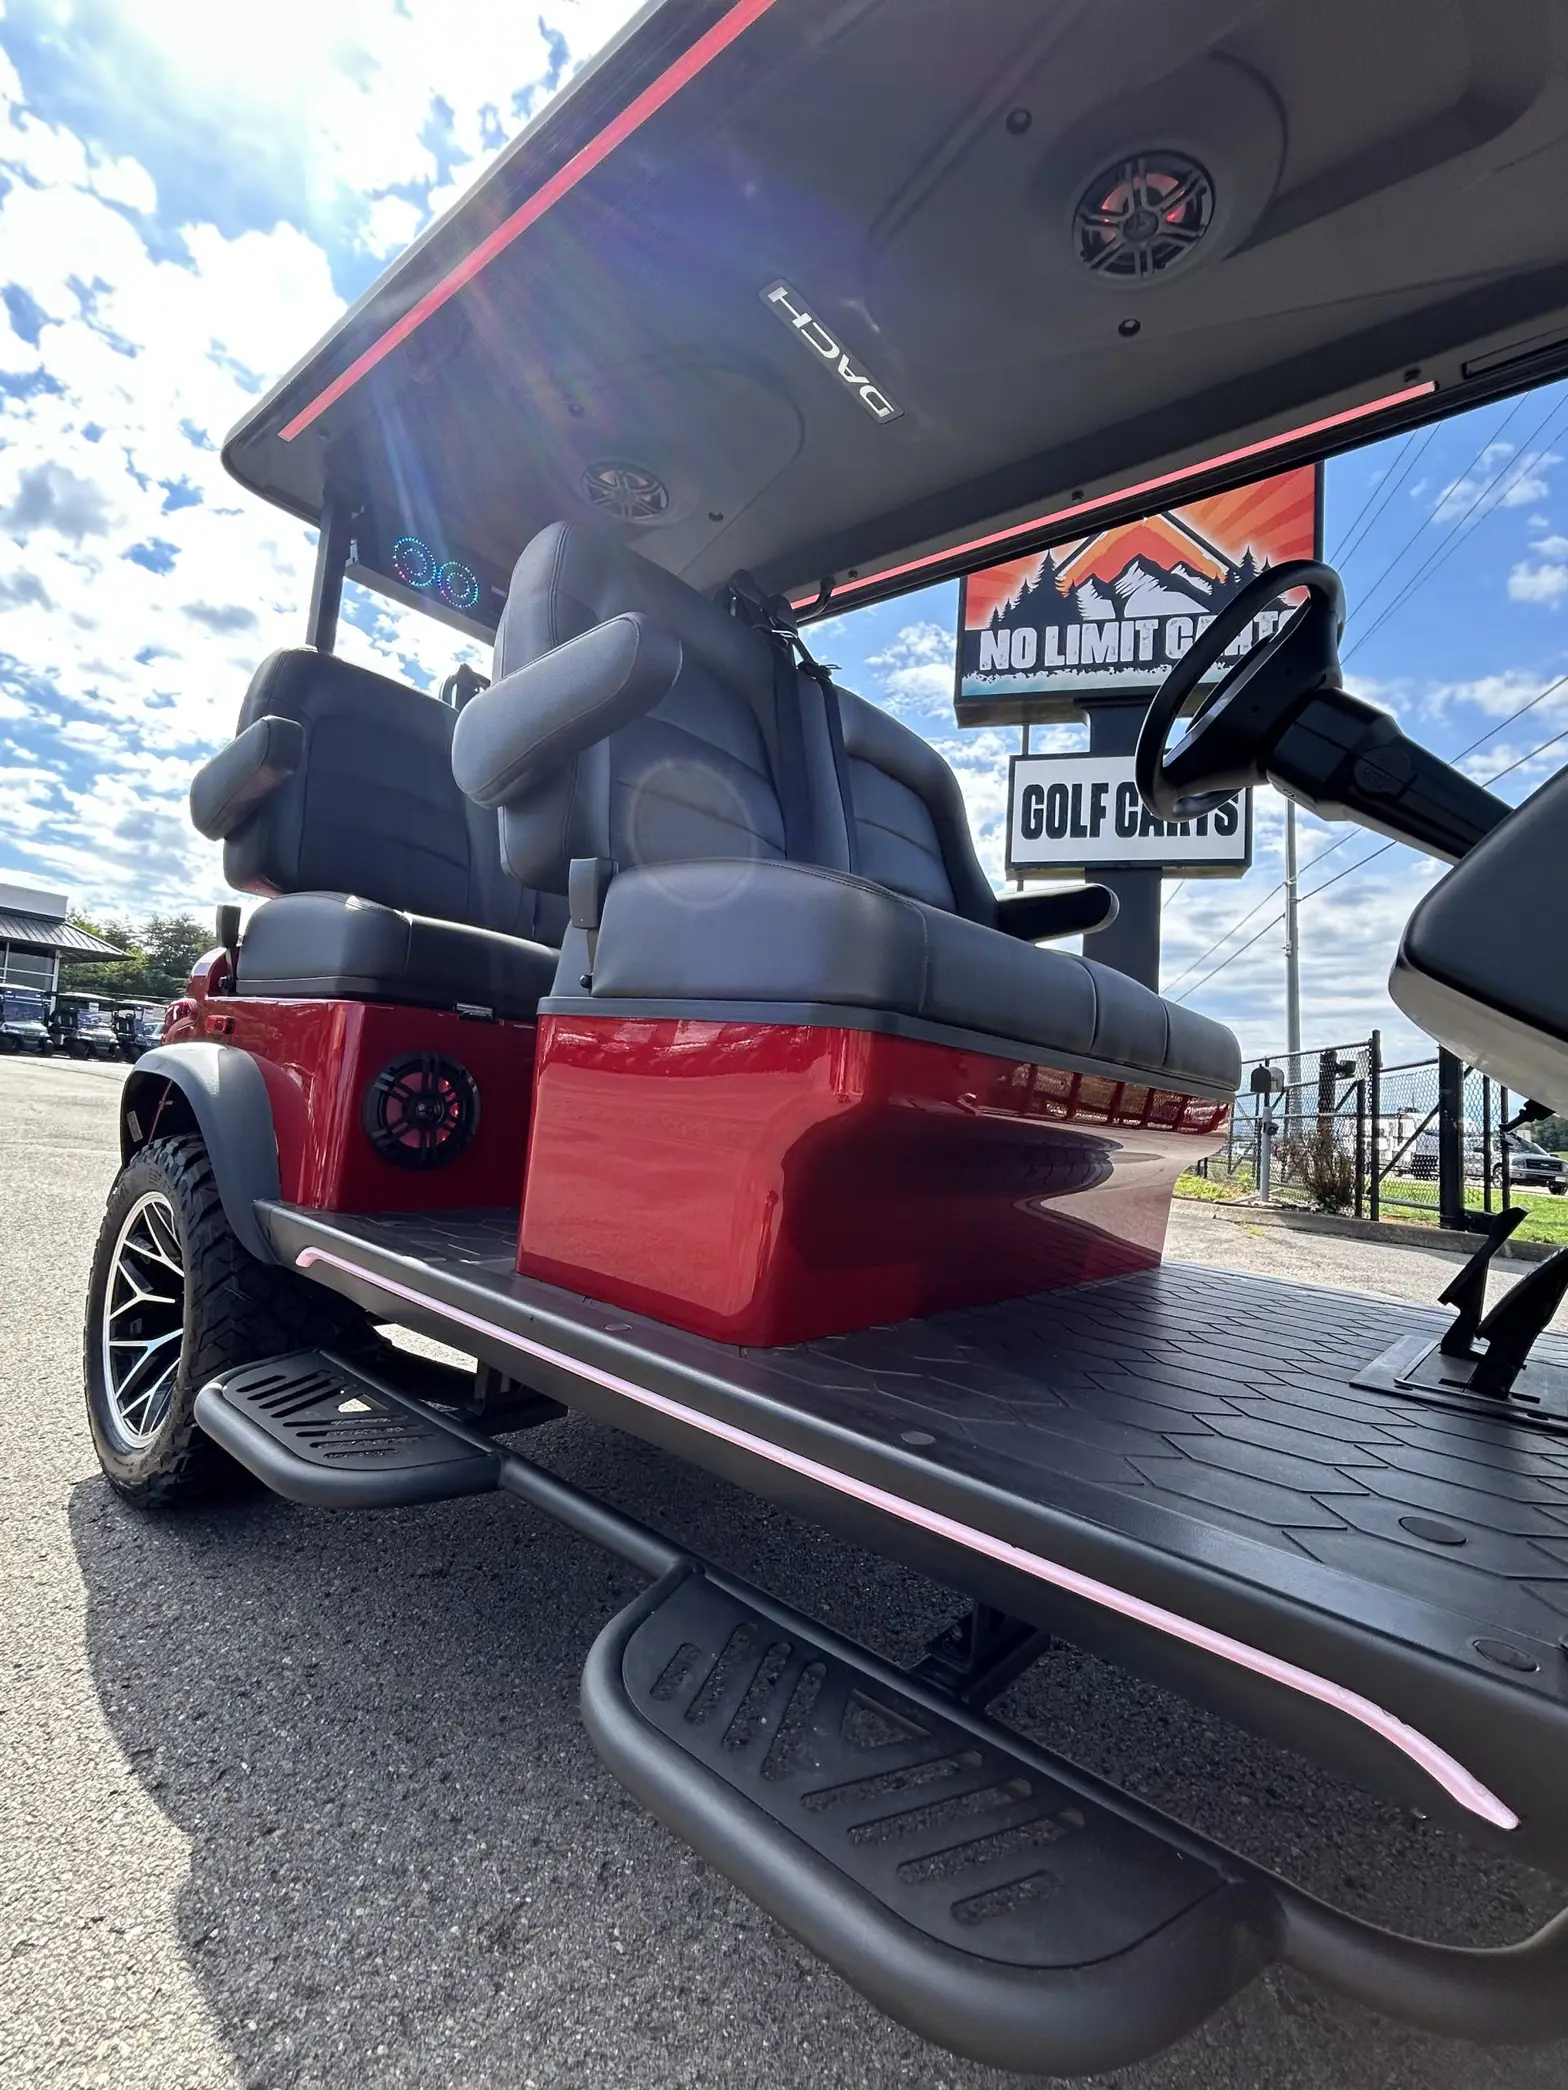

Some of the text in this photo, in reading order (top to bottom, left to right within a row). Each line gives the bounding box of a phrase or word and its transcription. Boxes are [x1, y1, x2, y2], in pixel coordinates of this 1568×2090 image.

[767, 286, 895, 418] DACH
[979, 628, 1038, 671] NO
[1044, 619, 1159, 667] LIMIT
[1020, 782, 1109, 840] GOLF
